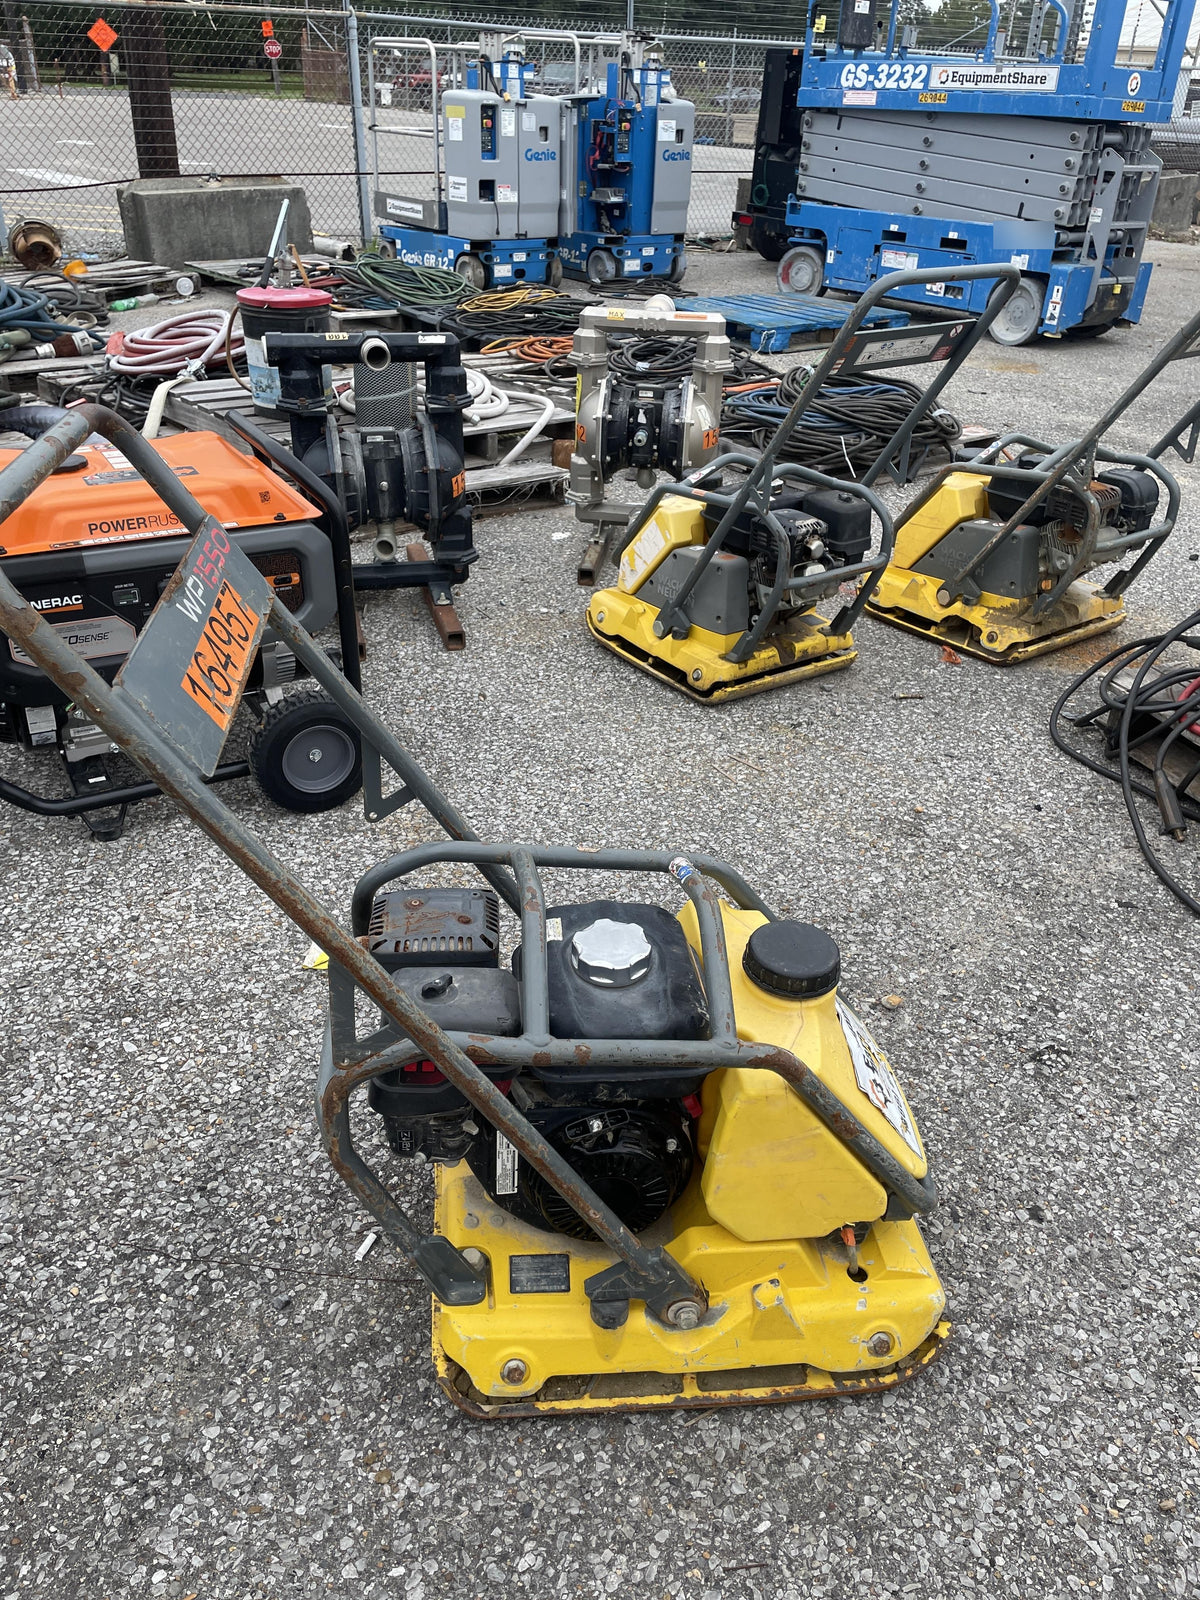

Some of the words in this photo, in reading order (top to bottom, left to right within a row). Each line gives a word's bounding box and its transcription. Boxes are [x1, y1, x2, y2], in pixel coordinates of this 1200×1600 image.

[265, 45, 281, 53] STOP
[840, 63, 928, 89] GS-3232
[951, 70, 1048, 86] EquipmentShare
[525, 148, 557, 162] Genie
[662, 149, 691, 162] Genie
[401, 249, 423, 265] Genie
[424, 253, 449, 270] GR-12
[608, 310, 625, 319] MAX
[88, 512, 182, 536] POWERRUS
[28, 594, 83, 611] NERAC
[62, 631, 110, 646] OSENSE
[185, 580, 254, 715] 164957
